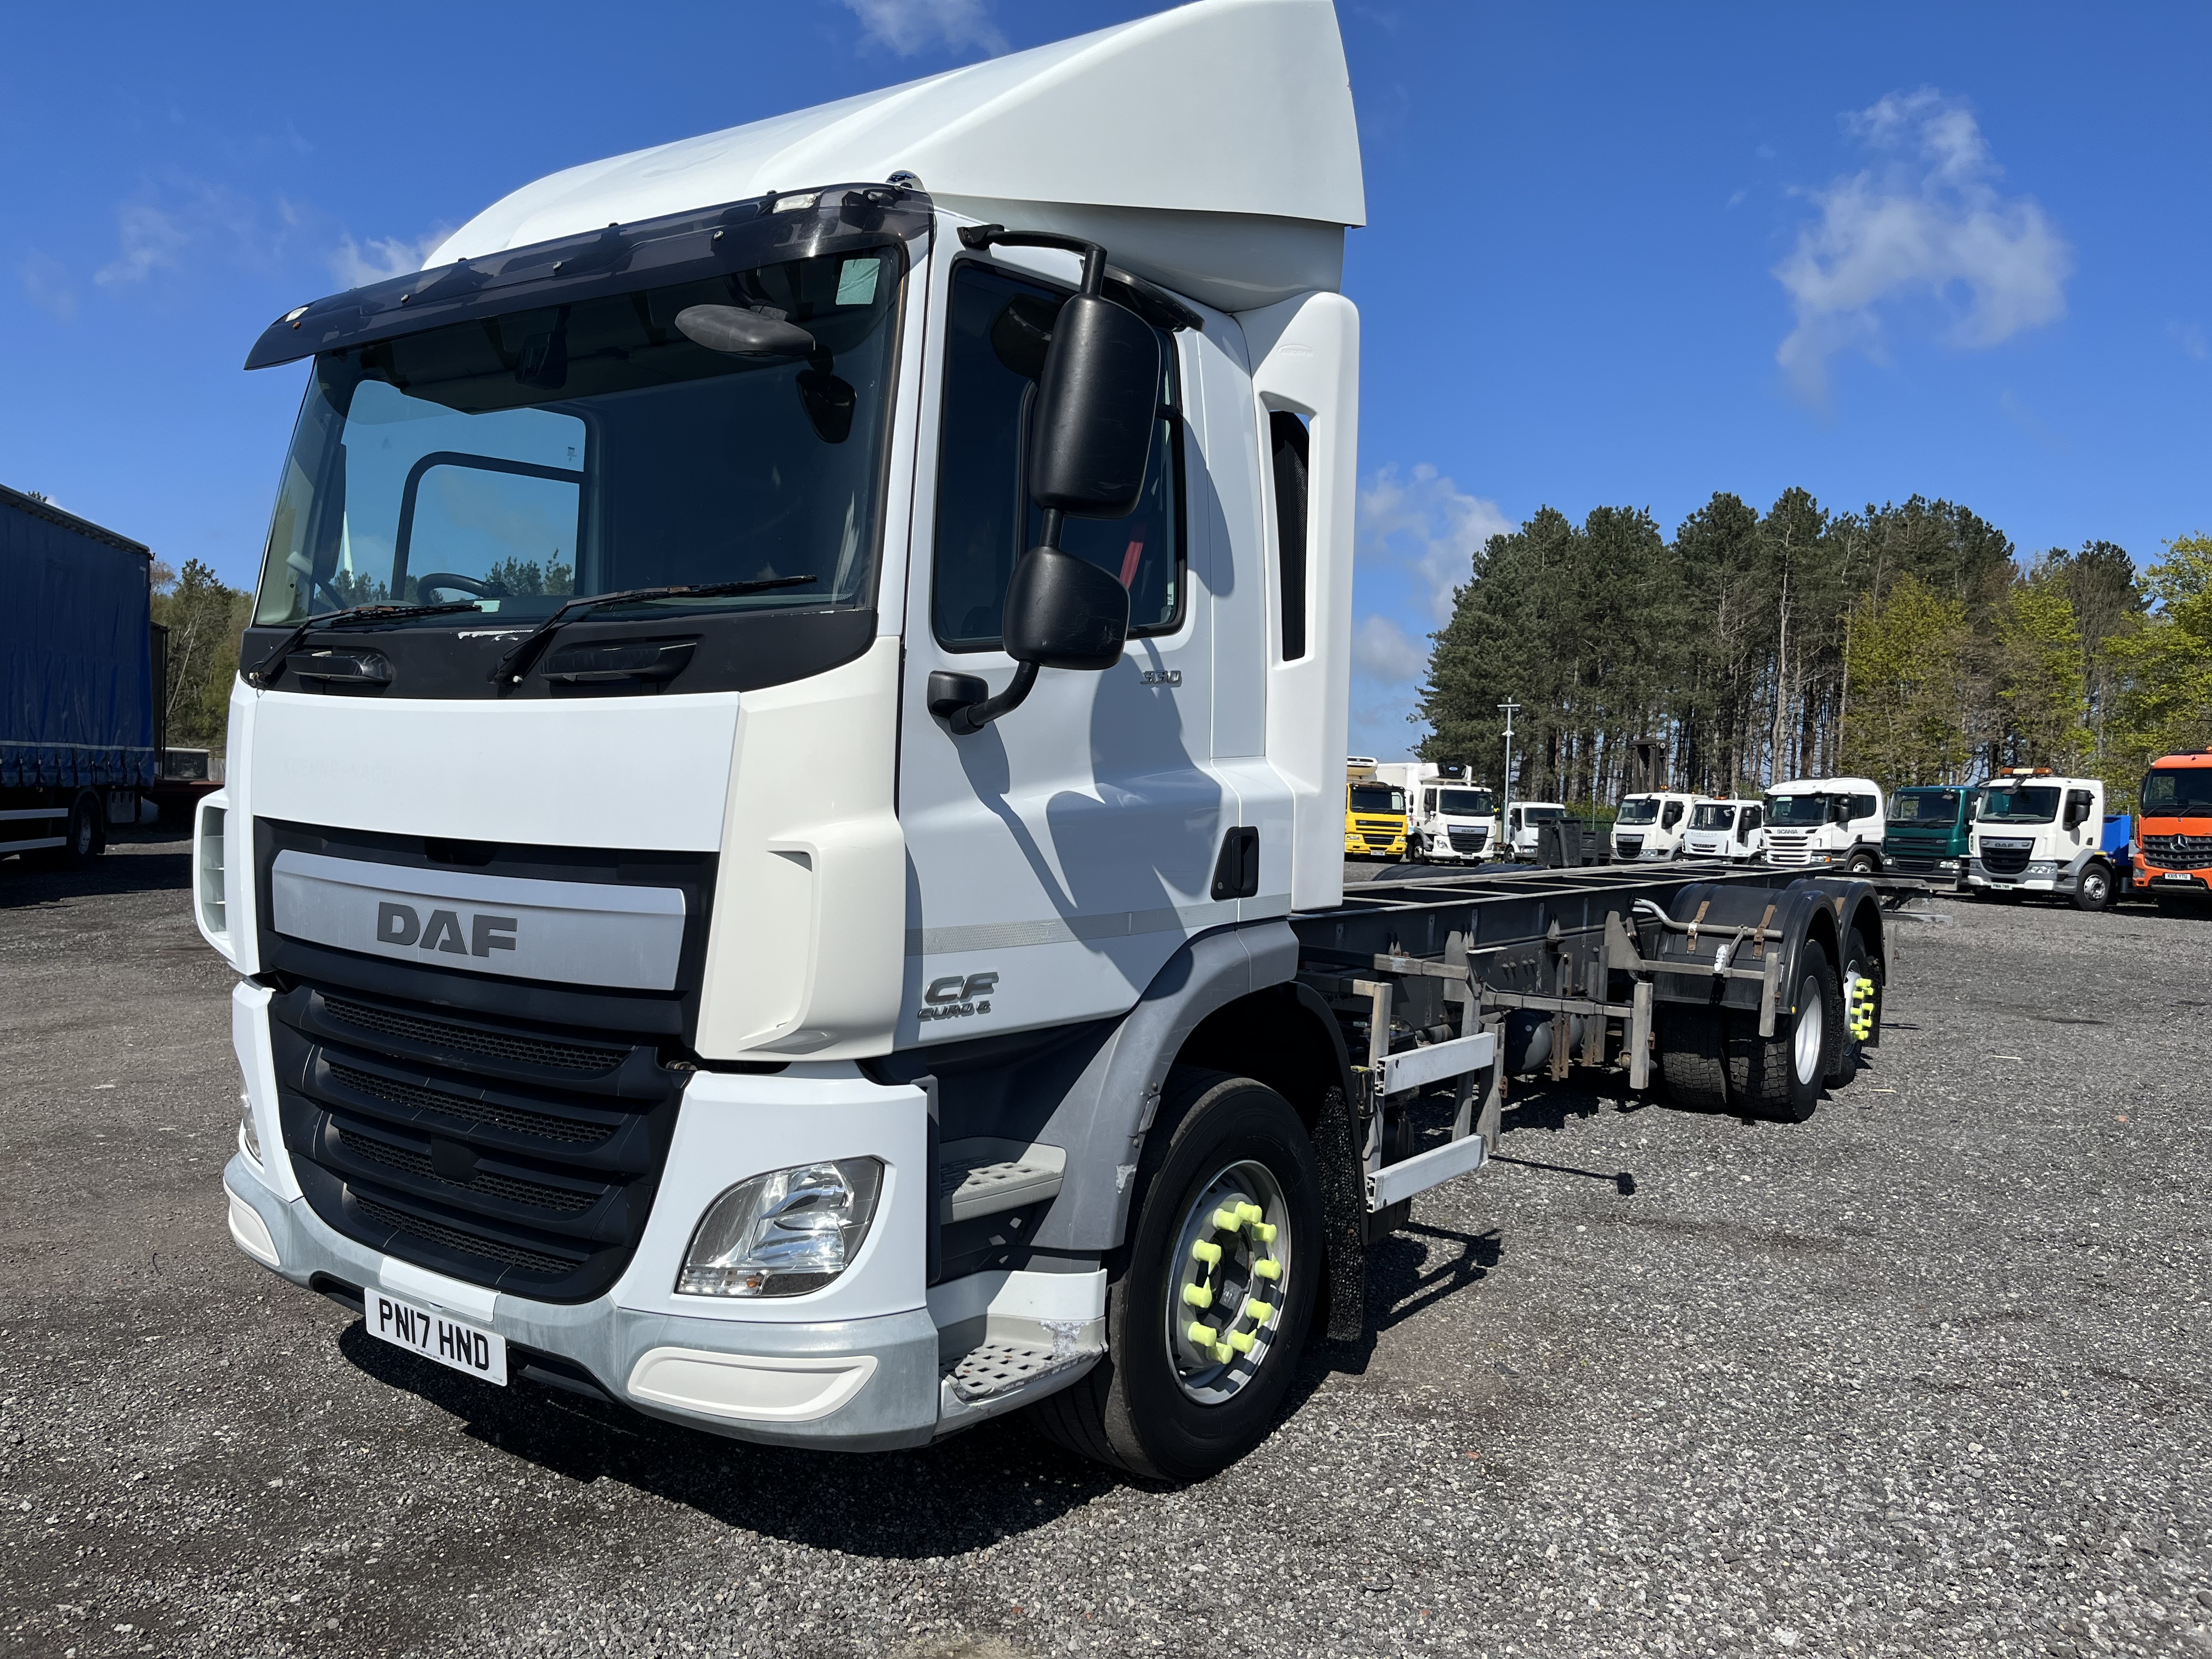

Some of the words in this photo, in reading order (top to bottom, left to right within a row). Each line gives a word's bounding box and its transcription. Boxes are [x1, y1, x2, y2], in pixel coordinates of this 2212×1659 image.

[1141, 670, 1182, 685] 330
[377, 901, 518, 957] DAF
[925, 972, 997, 1003] CF
[918, 1002, 973, 1020] EURO
[977, 1000, 991, 1014] 6
[379, 1297, 430, 1348] PN17
[438, 1320, 489, 1371] HND
